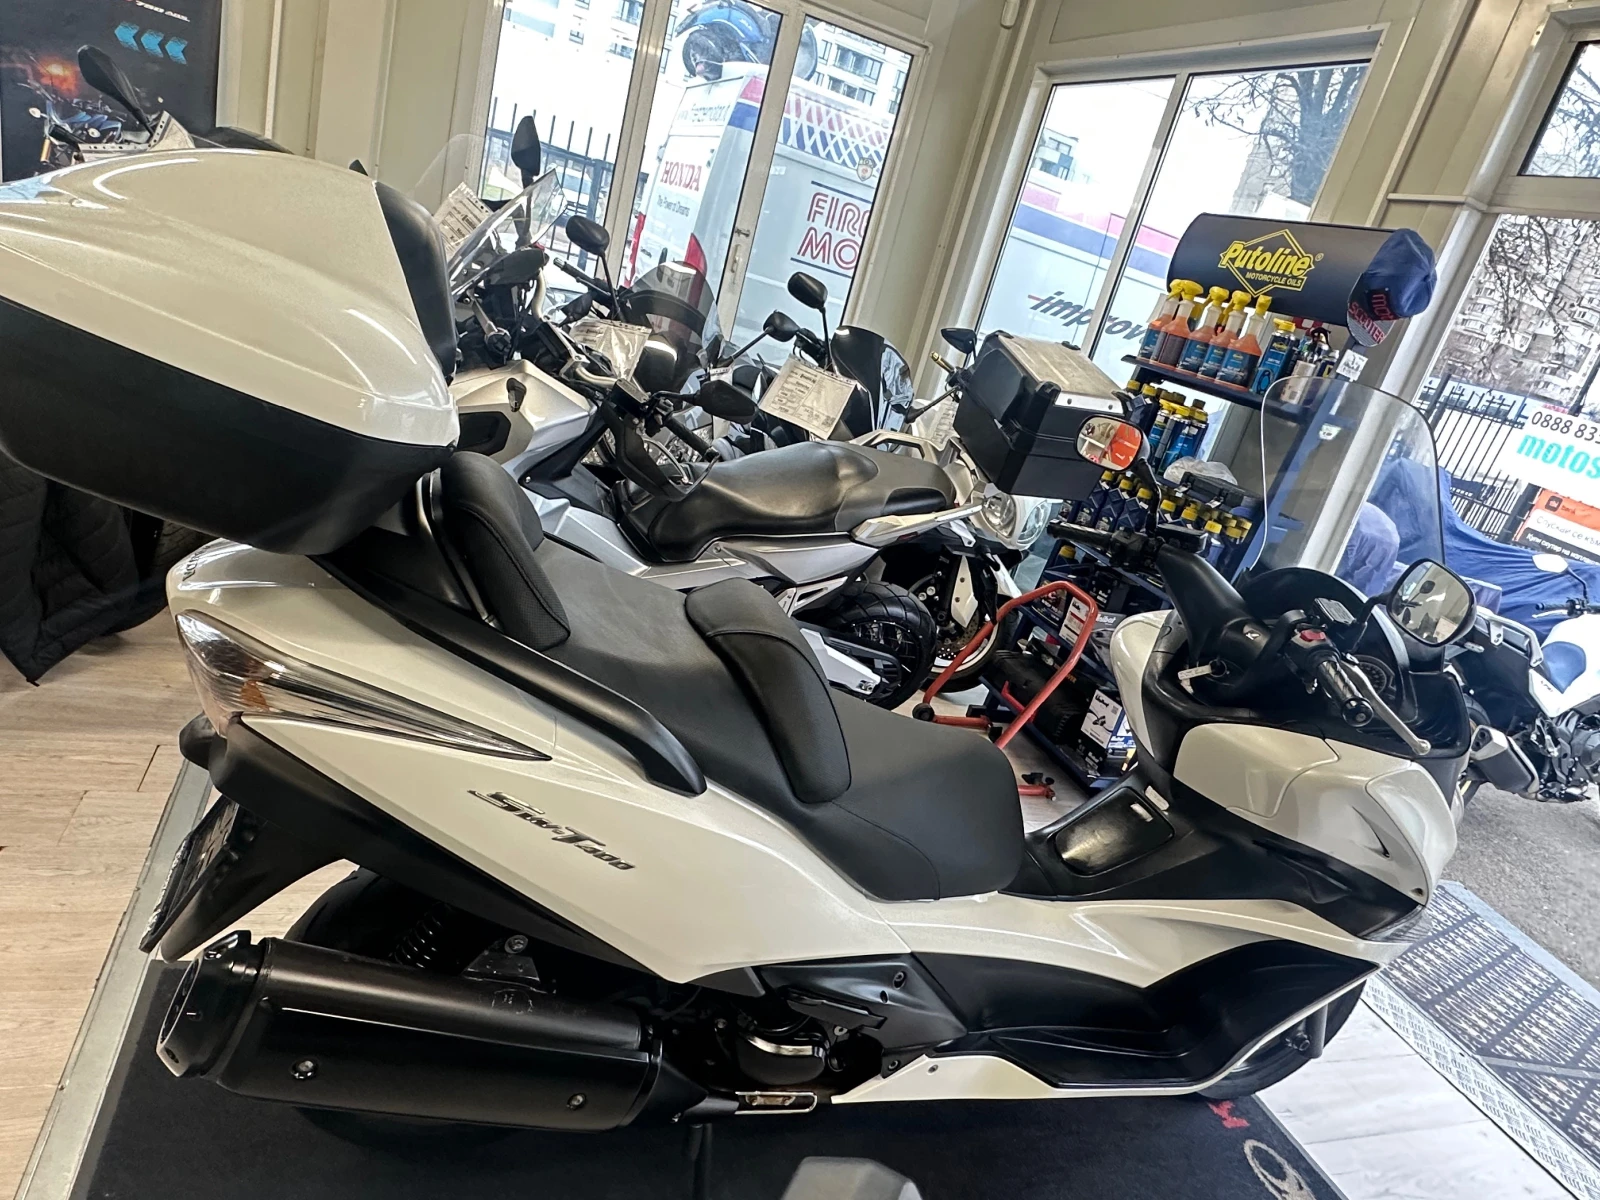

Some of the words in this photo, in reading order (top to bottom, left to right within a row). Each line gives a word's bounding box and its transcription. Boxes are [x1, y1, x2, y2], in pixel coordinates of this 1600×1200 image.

[660, 161, 702, 191] HONDA
[1220, 242, 1312, 277] Putoline
[1245, 271, 1287, 284] MOTORCYCLE
[1286, 279, 1303, 287] OILS
[1531, 411, 1573, 434] 0888
[1574, 423, 1600, 445] 83
[1516, 434, 1600, 479] motos
